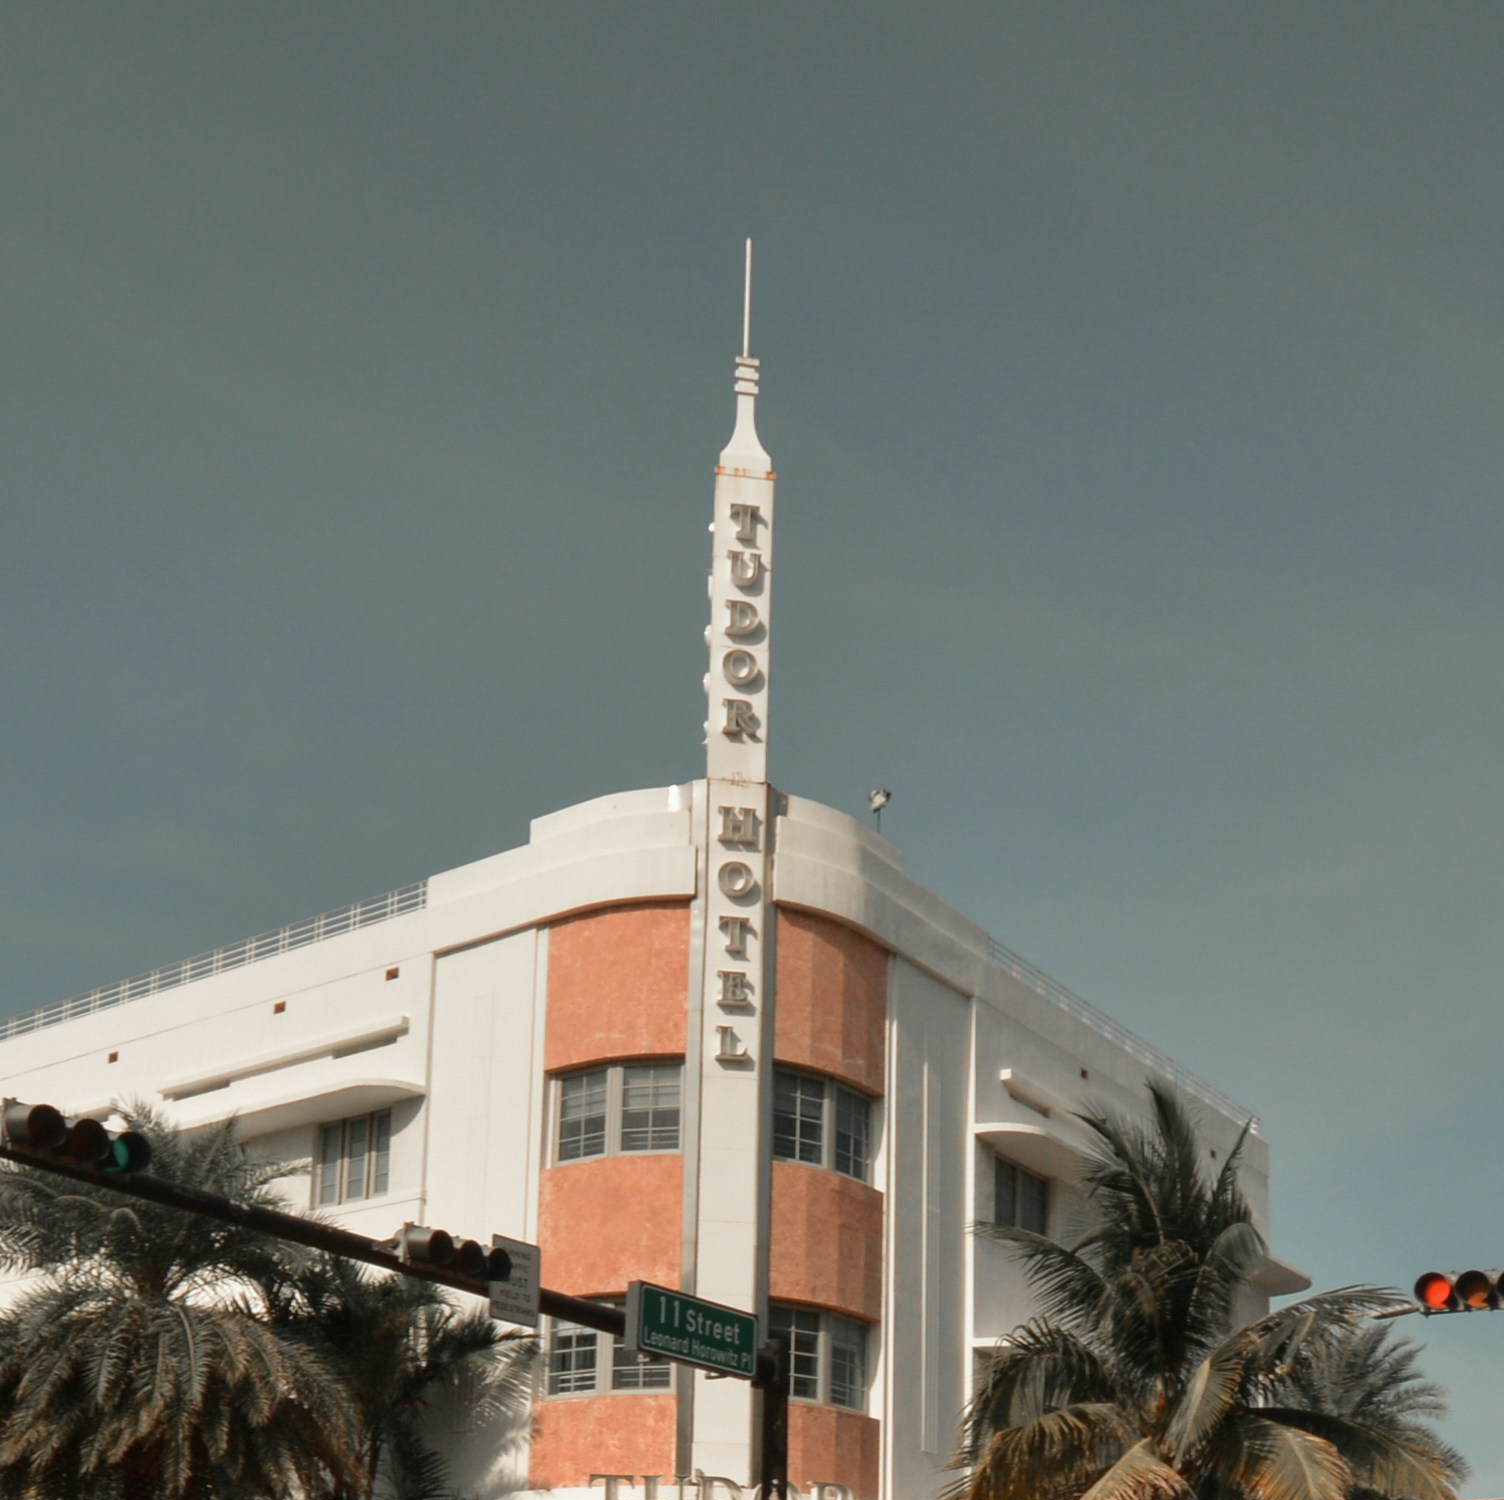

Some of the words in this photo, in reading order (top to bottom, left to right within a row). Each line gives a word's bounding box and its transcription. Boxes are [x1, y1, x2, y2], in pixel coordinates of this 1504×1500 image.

[722, 503, 762, 737] TUDOR
[715, 806, 757, 1062] HOTEL
[643, 1325, 689, 1354] Leonard
[691, 1338, 738, 1367] Horowitz
[659, 1296, 680, 1328] 11
[685, 1309, 740, 1345] Street
